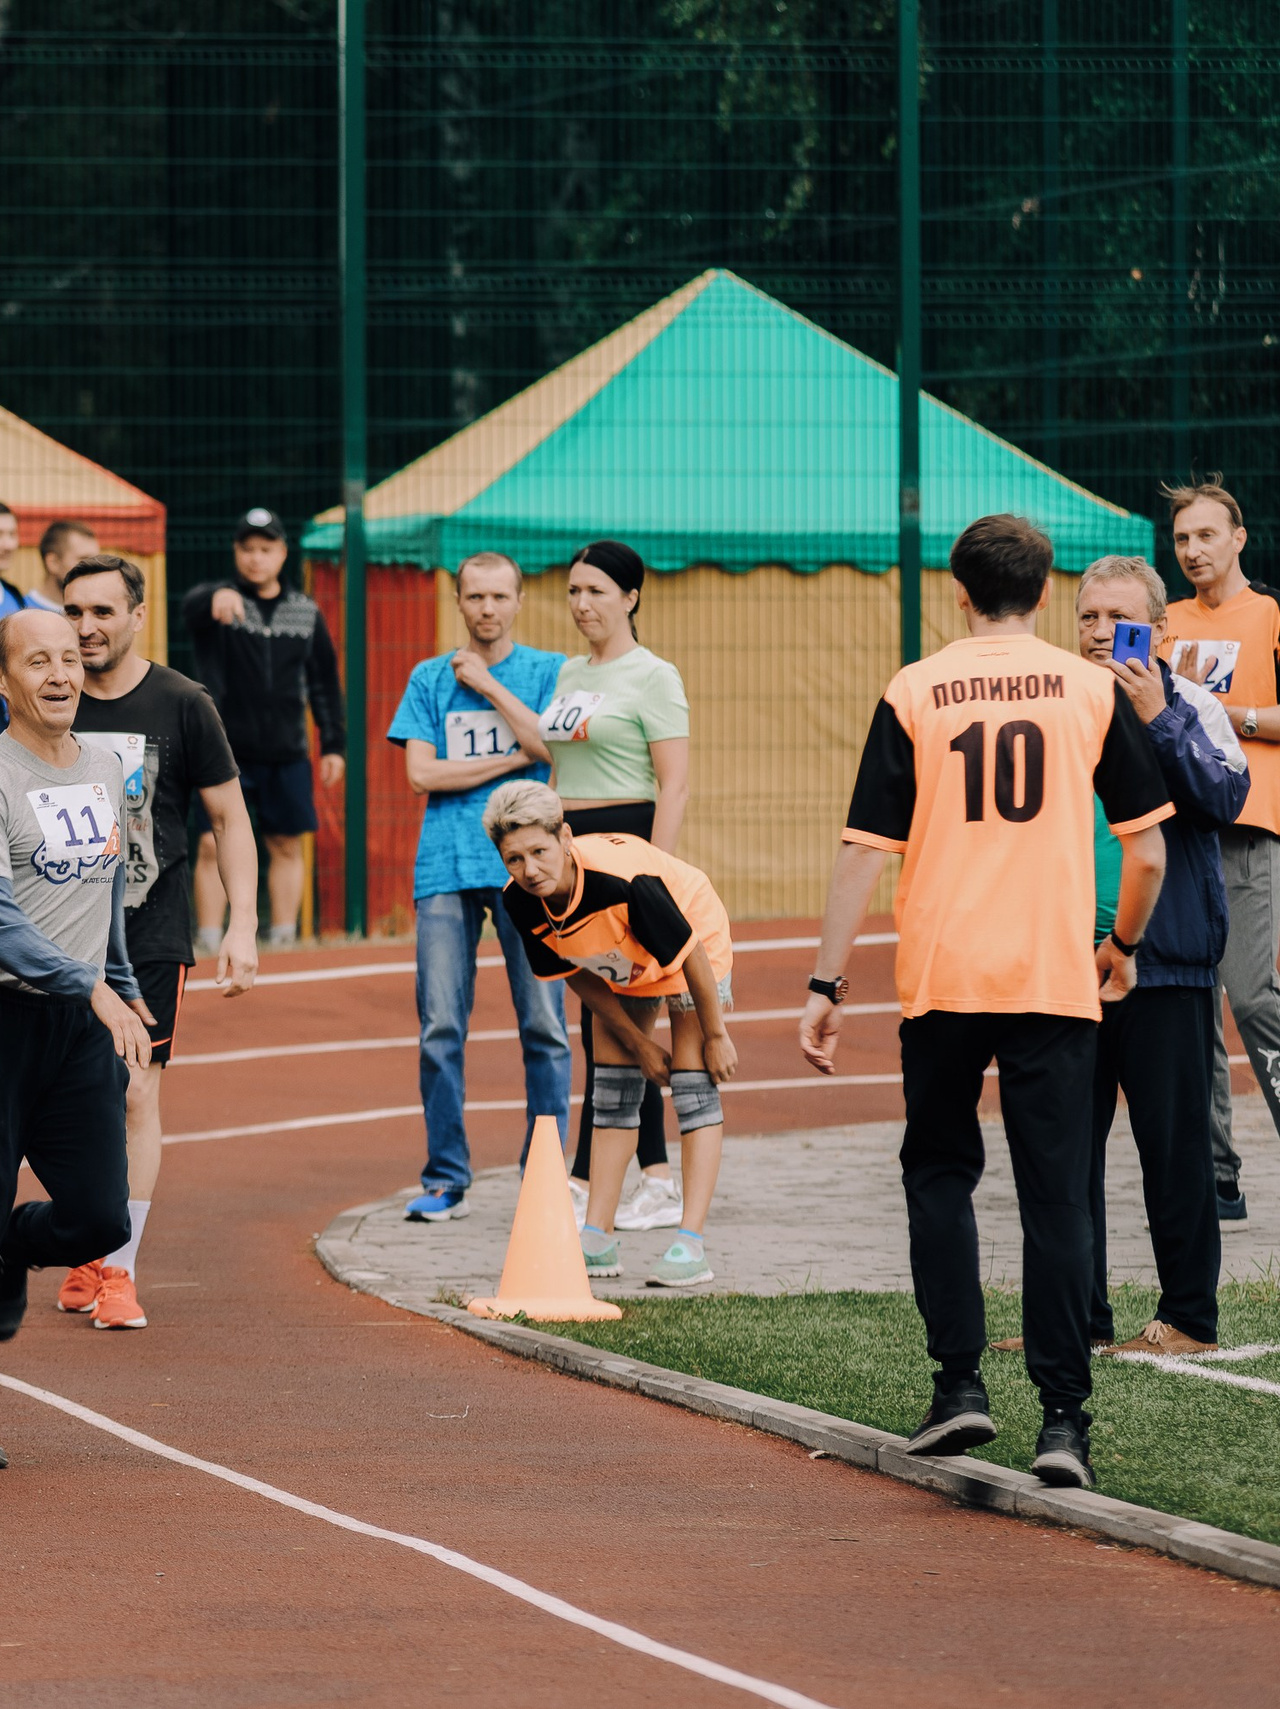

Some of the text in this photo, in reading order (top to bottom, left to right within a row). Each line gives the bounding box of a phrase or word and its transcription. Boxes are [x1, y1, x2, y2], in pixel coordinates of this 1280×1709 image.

[932, 673, 1065, 710] ПОЛИКОМ
[1219, 679, 1227, 692] 1
[548, 706, 583, 732] 10
[463, 727, 505, 757] 11
[949, 719, 1046, 823] 10
[127, 779, 137, 792] 4
[56, 805, 107, 847] 11
[111, 835, 118, 851] 2
